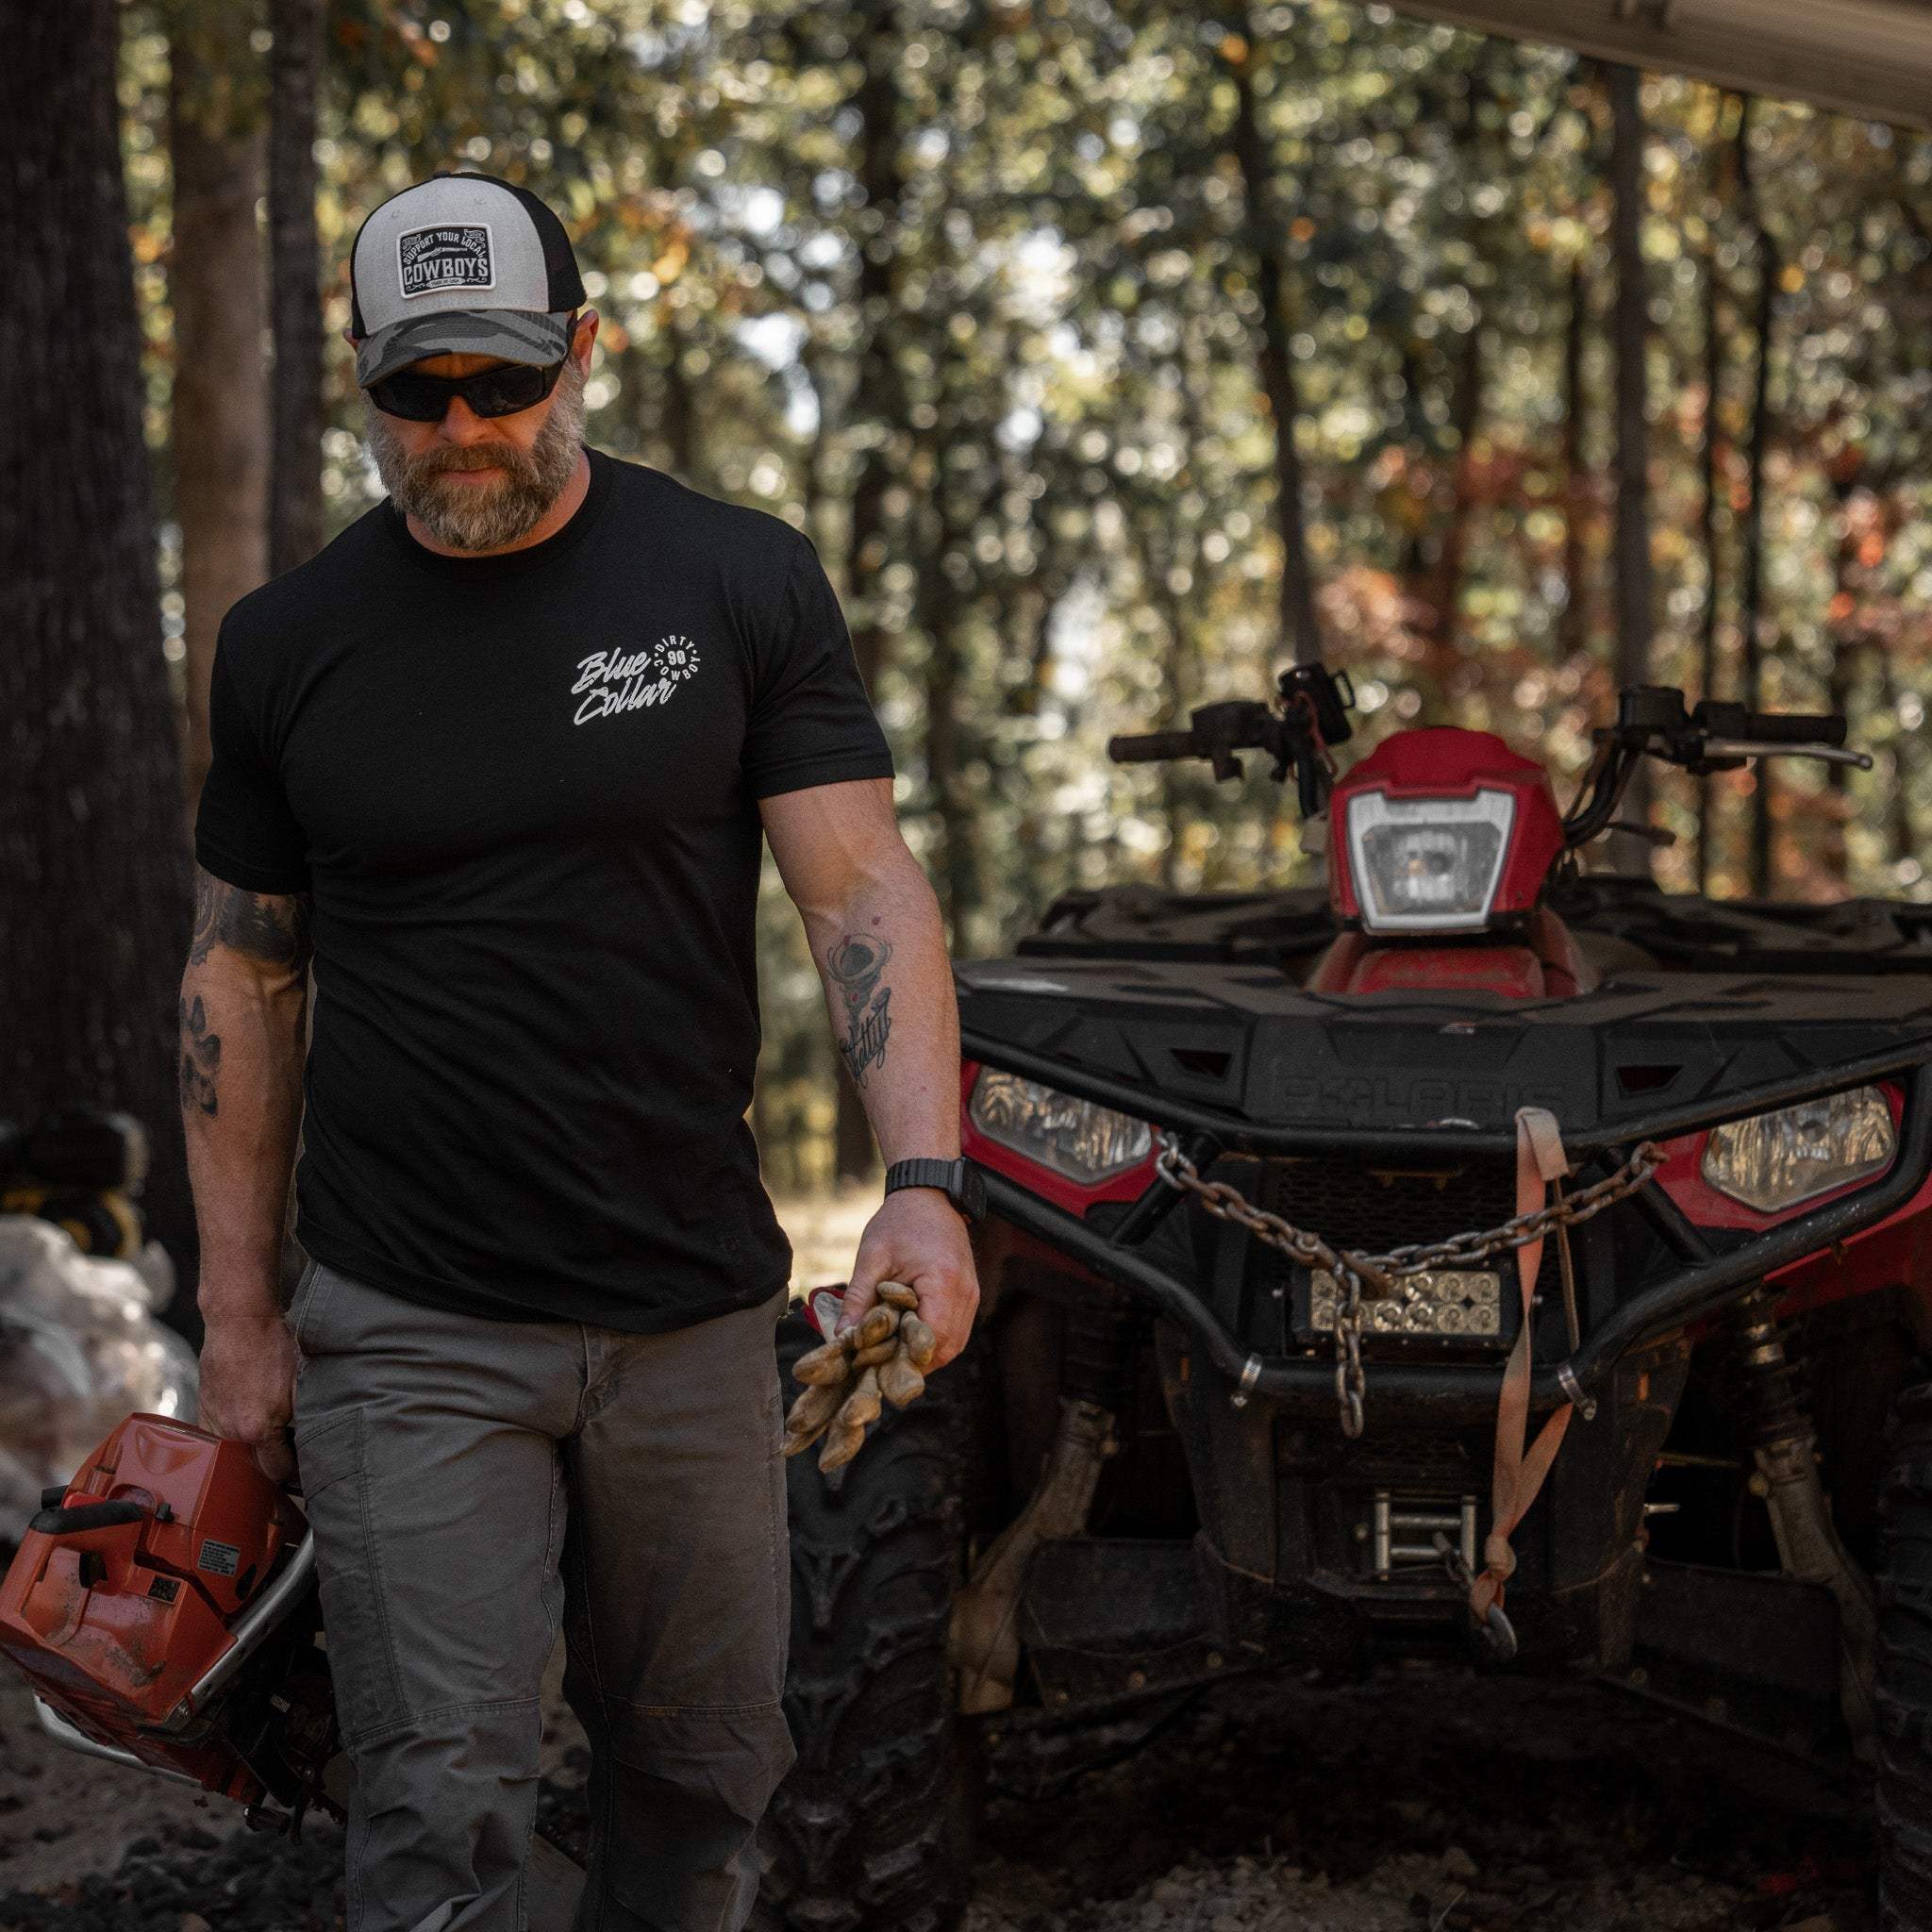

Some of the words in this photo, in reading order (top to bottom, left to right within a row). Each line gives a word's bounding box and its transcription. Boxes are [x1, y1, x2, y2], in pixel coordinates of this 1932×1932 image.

[404, 233, 434, 265] SUPPORT
[436, 232, 459, 242] YOUR
[460, 236, 487, 258] LOCAL
[404, 258, 489, 286] COWBOYS
[655, 635, 695, 653] DIRTY
[571, 647, 652, 694] Blue
[654, 656, 701, 681] COWBOY
[574, 674, 677, 725] Collar
